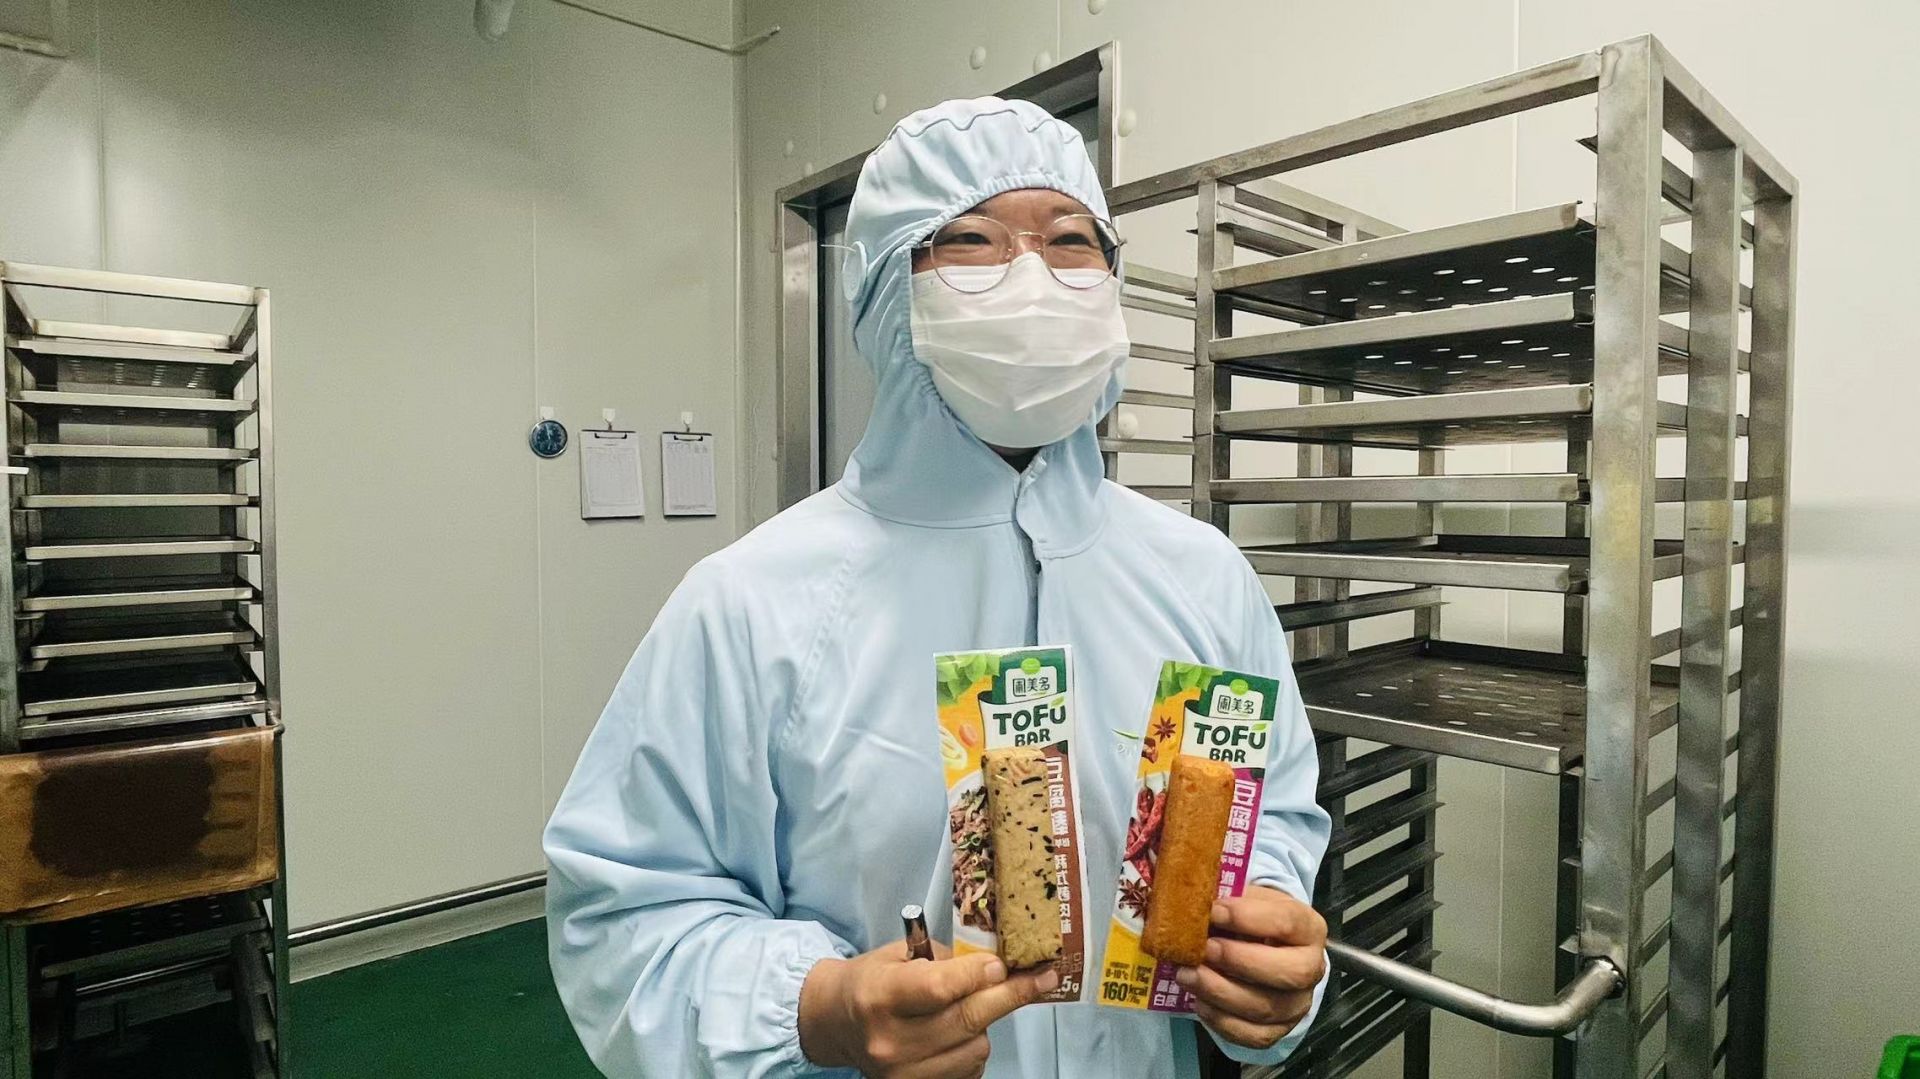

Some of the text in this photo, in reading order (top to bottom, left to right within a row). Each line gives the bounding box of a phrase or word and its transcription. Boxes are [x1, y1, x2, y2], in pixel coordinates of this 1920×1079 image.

[1012, 676, 1051, 697] 圃美多
[1217, 694, 1254, 715] 圃美多
[992, 703, 1067, 735] TOFU
[1014, 728, 1051, 747] BAR
[1194, 721, 1266, 750] TOFU
[1209, 747, 1246, 764] BAR
[1222, 778, 1257, 856] 豆腐棒
[1056, 974, 1080, 993] .5g
[1102, 980, 1129, 1002] 160
[1129, 983, 1149, 997] kcal
